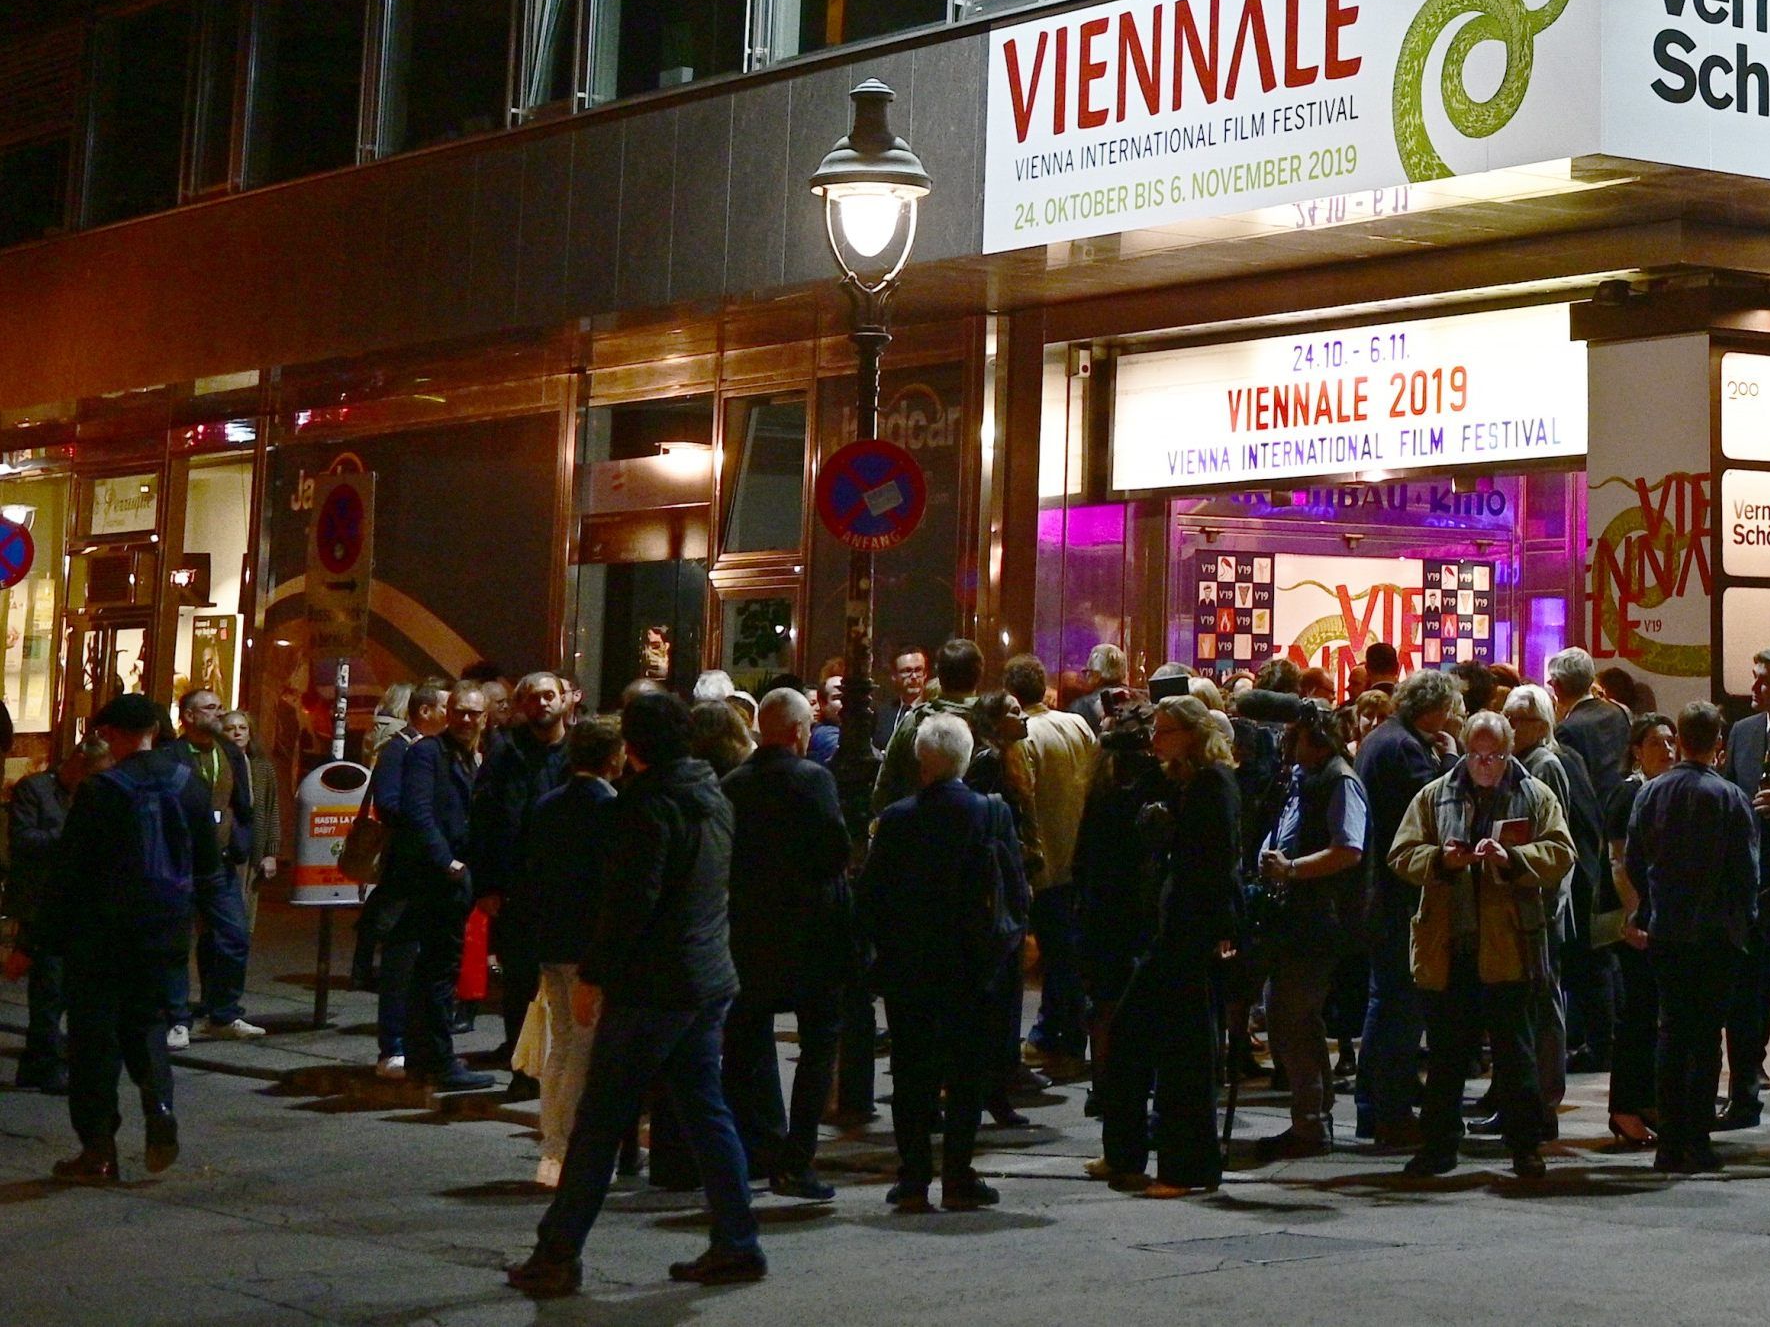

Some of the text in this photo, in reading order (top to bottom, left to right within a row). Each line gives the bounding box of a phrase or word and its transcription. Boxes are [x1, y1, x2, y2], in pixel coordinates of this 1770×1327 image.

[1015, 94, 1359, 181] VIENNA INTERNATIONAL FILM FESTIVAL
[1014, 144, 1359, 231] 24. OKTOBER BIS 6. NOVEMBER 2019
[1293, 340, 1349, 372] 24.10.
[1370, 333, 1410, 363] 6.11.
[1228, 365, 1468, 433] VIENNALE 2019
[1167, 417, 1561, 476] VIENNA INTERNATIONAL FILM FESTIVAL
[842, 531, 901, 549] ANFANG
[314, 816, 338, 825] HASTA
